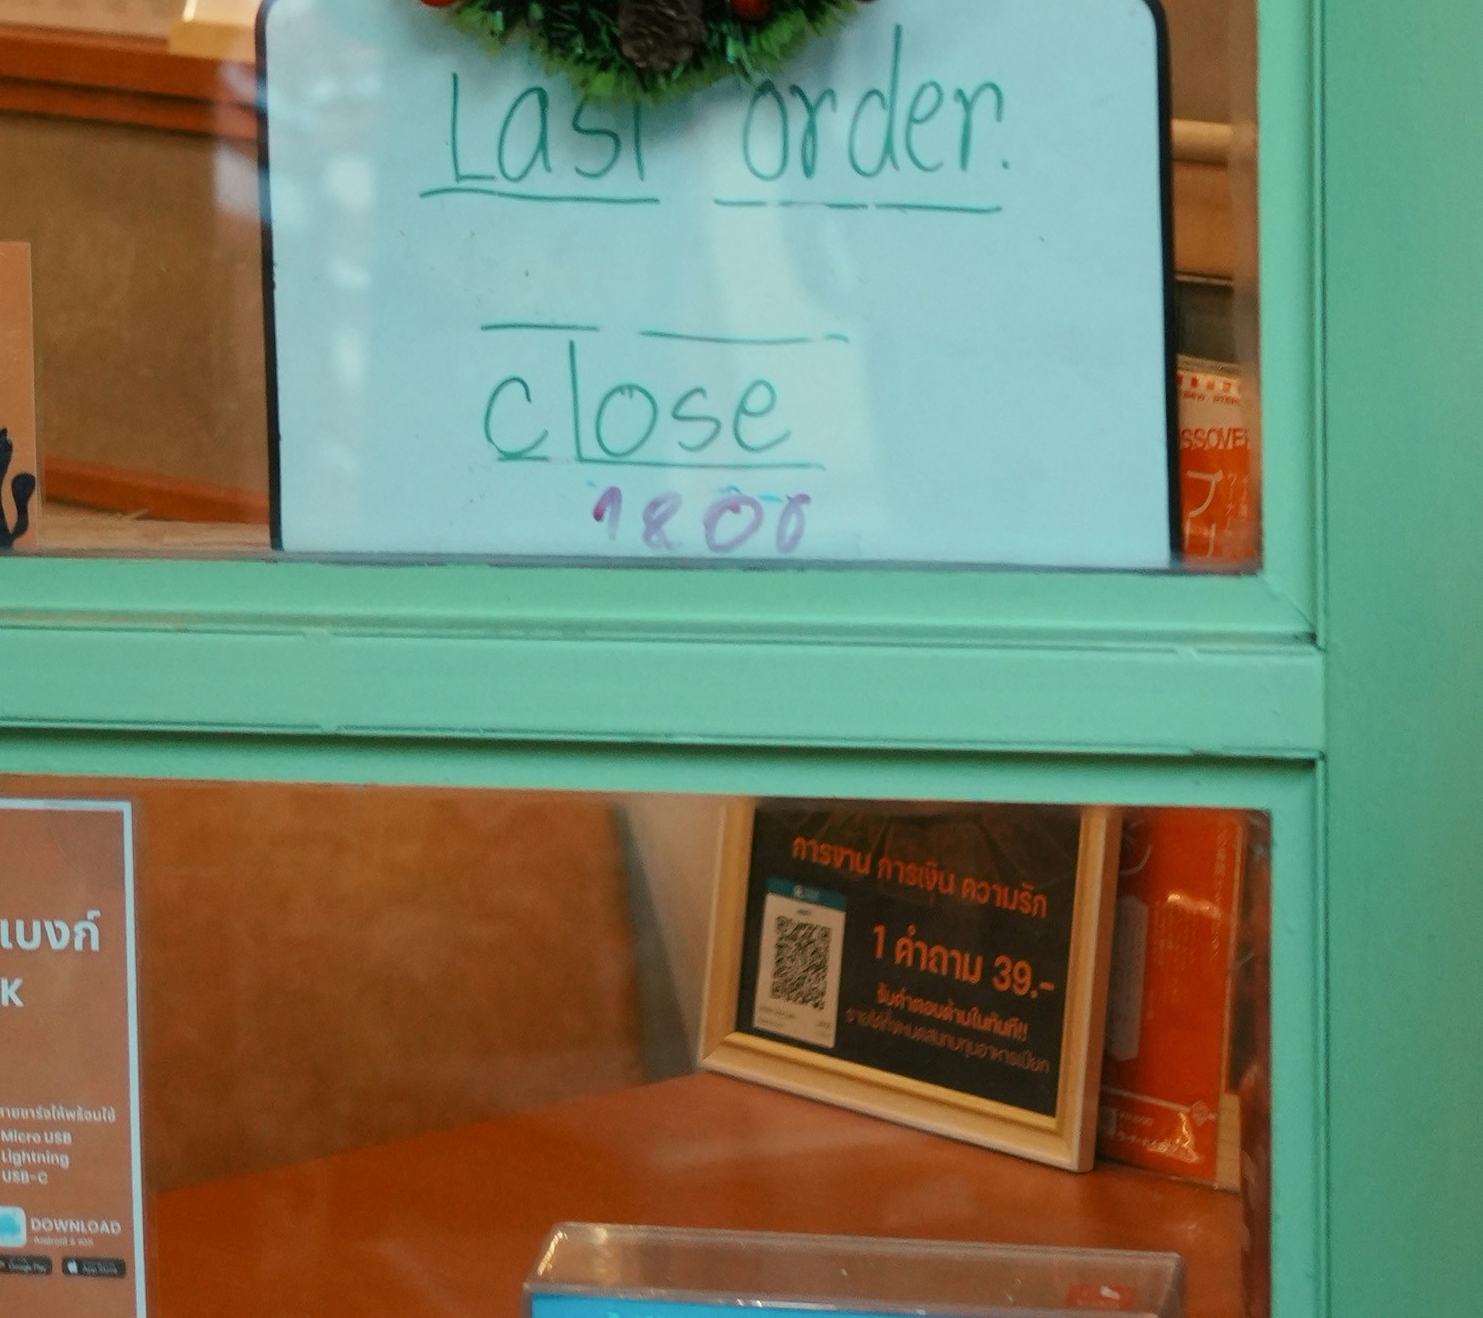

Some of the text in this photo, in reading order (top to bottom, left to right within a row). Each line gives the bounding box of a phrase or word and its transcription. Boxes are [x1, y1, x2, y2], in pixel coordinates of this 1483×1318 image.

[791, 836, 1048, 919] การงาน การเงิน ความรัก
[873, 923, 1056, 1000] 1 คำถาม 39.-
[0, 1129, 72, 1146] Micro USB
[1, 1148, 70, 1169] Lightning
[30, 1217, 122, 1236] DOWNLOAD
